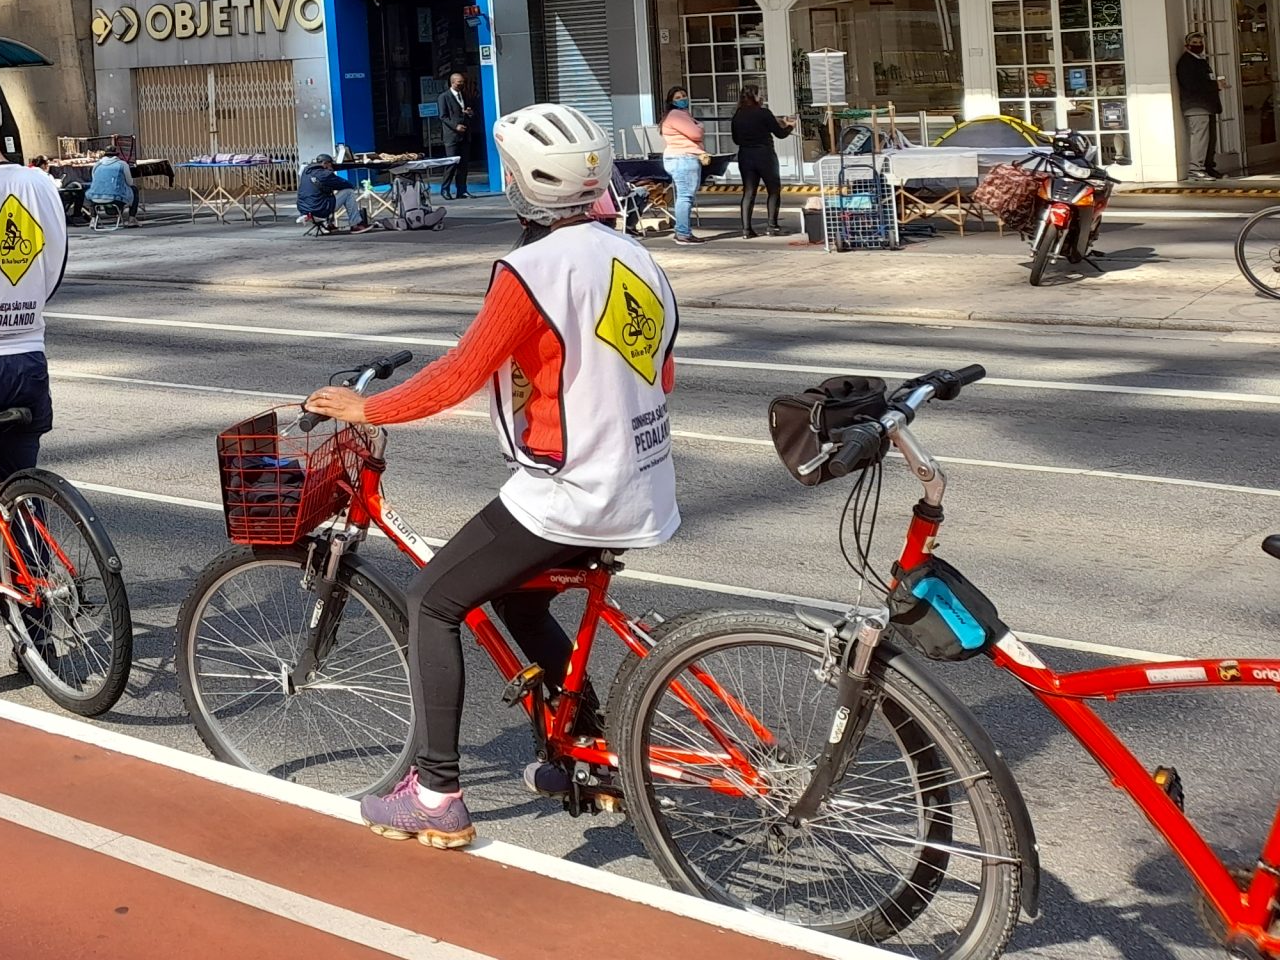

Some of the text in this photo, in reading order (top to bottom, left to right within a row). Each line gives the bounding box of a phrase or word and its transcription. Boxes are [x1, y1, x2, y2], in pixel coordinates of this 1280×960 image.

[12, 300, 21, 311] SÃO
[22, 300, 37, 311] PAULO
[631, 410, 656, 431] CONHEÇA
[385, 510, 417, 545] btwin
